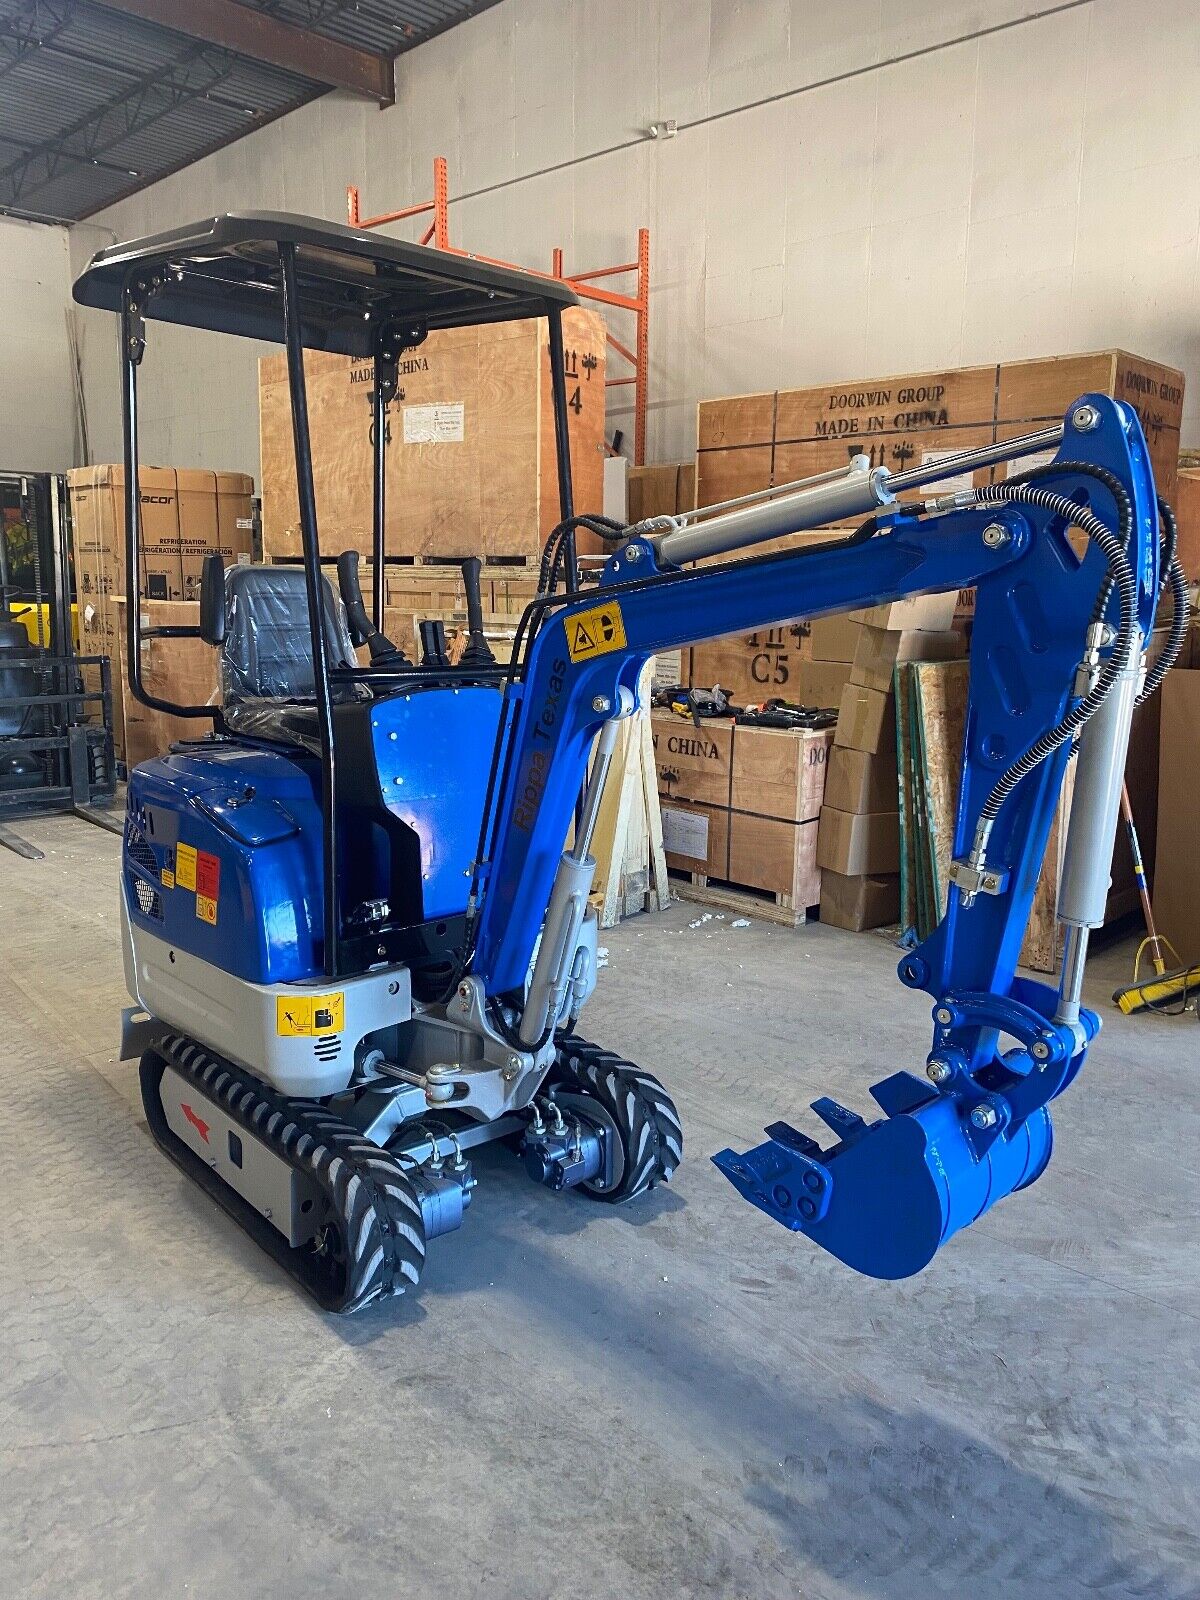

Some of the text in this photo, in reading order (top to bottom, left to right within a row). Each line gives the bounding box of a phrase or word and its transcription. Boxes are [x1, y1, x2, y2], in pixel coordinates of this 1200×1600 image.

[350, 357, 429, 384] MADE CHINA
[829, 385, 945, 410] DOORWIN GROUP
[815, 408, 949, 436] MADE IN CHINA
[139, 493, 174, 505] acor
[139, 546, 181, 554] EFRIGÉRATION
[159, 538, 207, 546] REFRIGERATION
[751, 653, 789, 685] C5
[512, 655, 568, 833] Rippa Texas
[667, 736, 719, 760] CHINA
